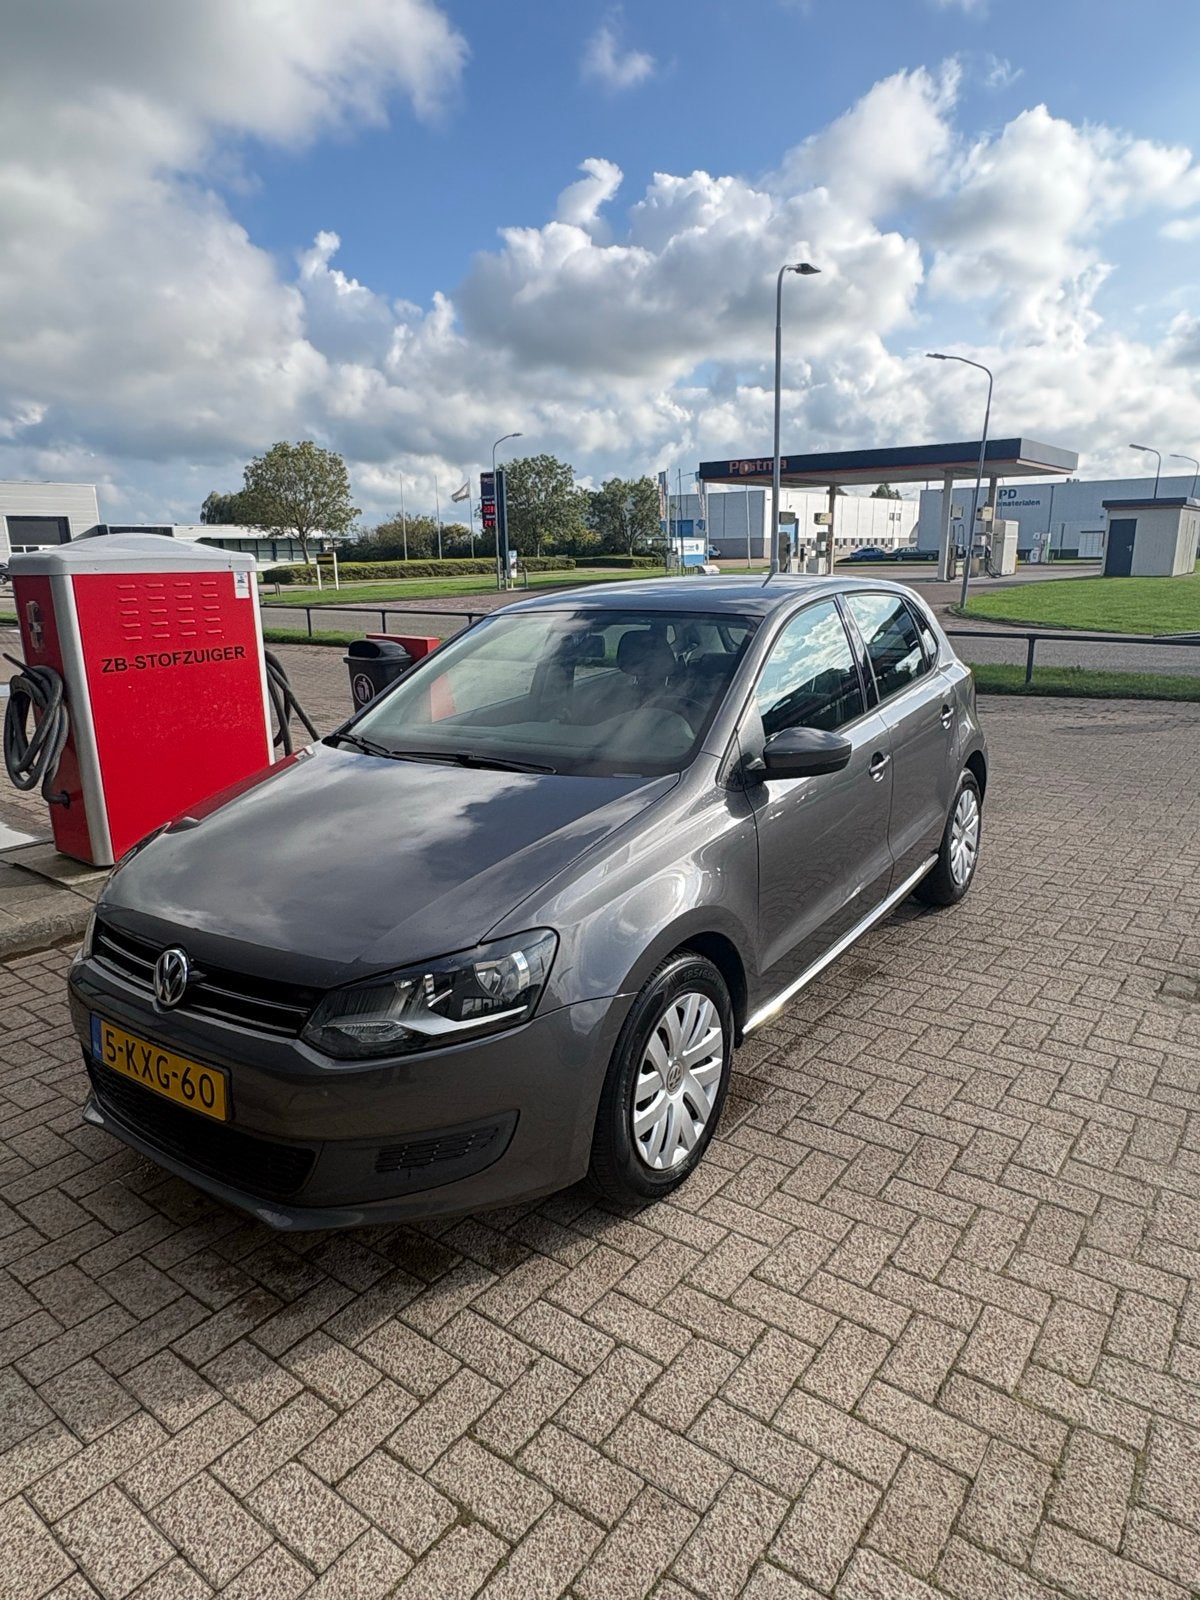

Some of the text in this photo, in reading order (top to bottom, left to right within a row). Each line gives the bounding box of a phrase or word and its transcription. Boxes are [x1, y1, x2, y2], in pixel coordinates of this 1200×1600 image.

[729, 459, 787, 475] Postma
[999, 489, 1017, 499] PD
[101, 646, 246, 674] ZB-STOFZUIGER
[105, 1029, 215, 1109] 5-KXG-60
